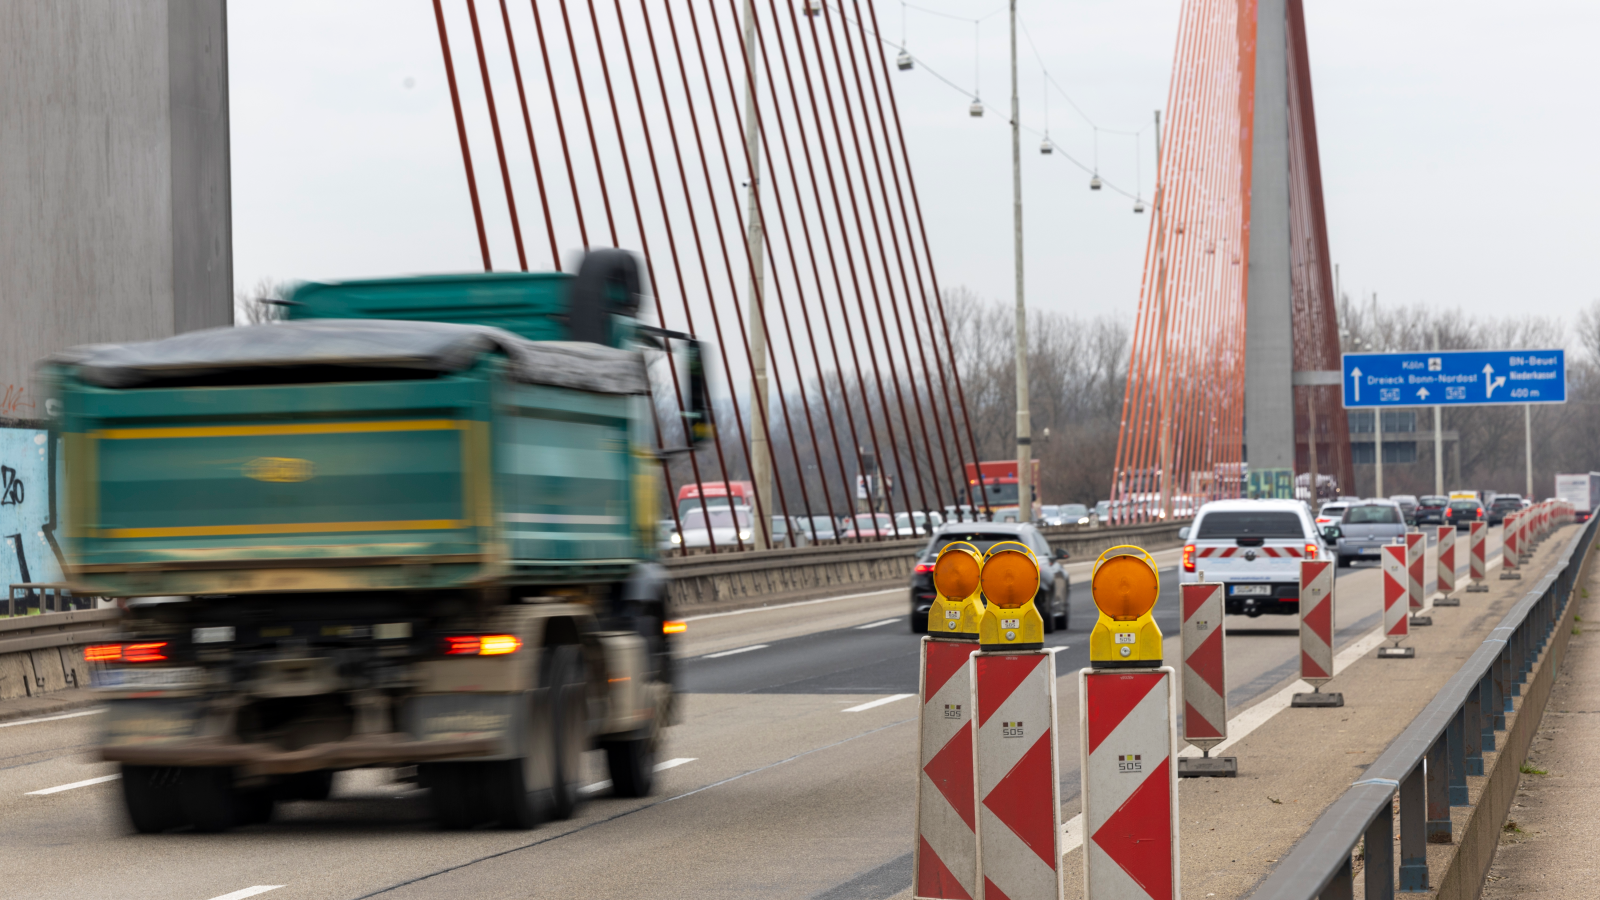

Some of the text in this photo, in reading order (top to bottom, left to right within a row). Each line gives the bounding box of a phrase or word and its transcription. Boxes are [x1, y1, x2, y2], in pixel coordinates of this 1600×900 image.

[1402, 360, 1424, 370] Köln
[1509, 356, 1557, 366] BN-Beuel
[1367, 374, 1477, 385] Dreieck Bonn-Nordost
[1510, 371, 1556, 380] Niederkassel
[1510, 388, 1529, 398] 400
[1003, 728, 1024, 736] SOS
[1119, 762, 1142, 771] SOS
